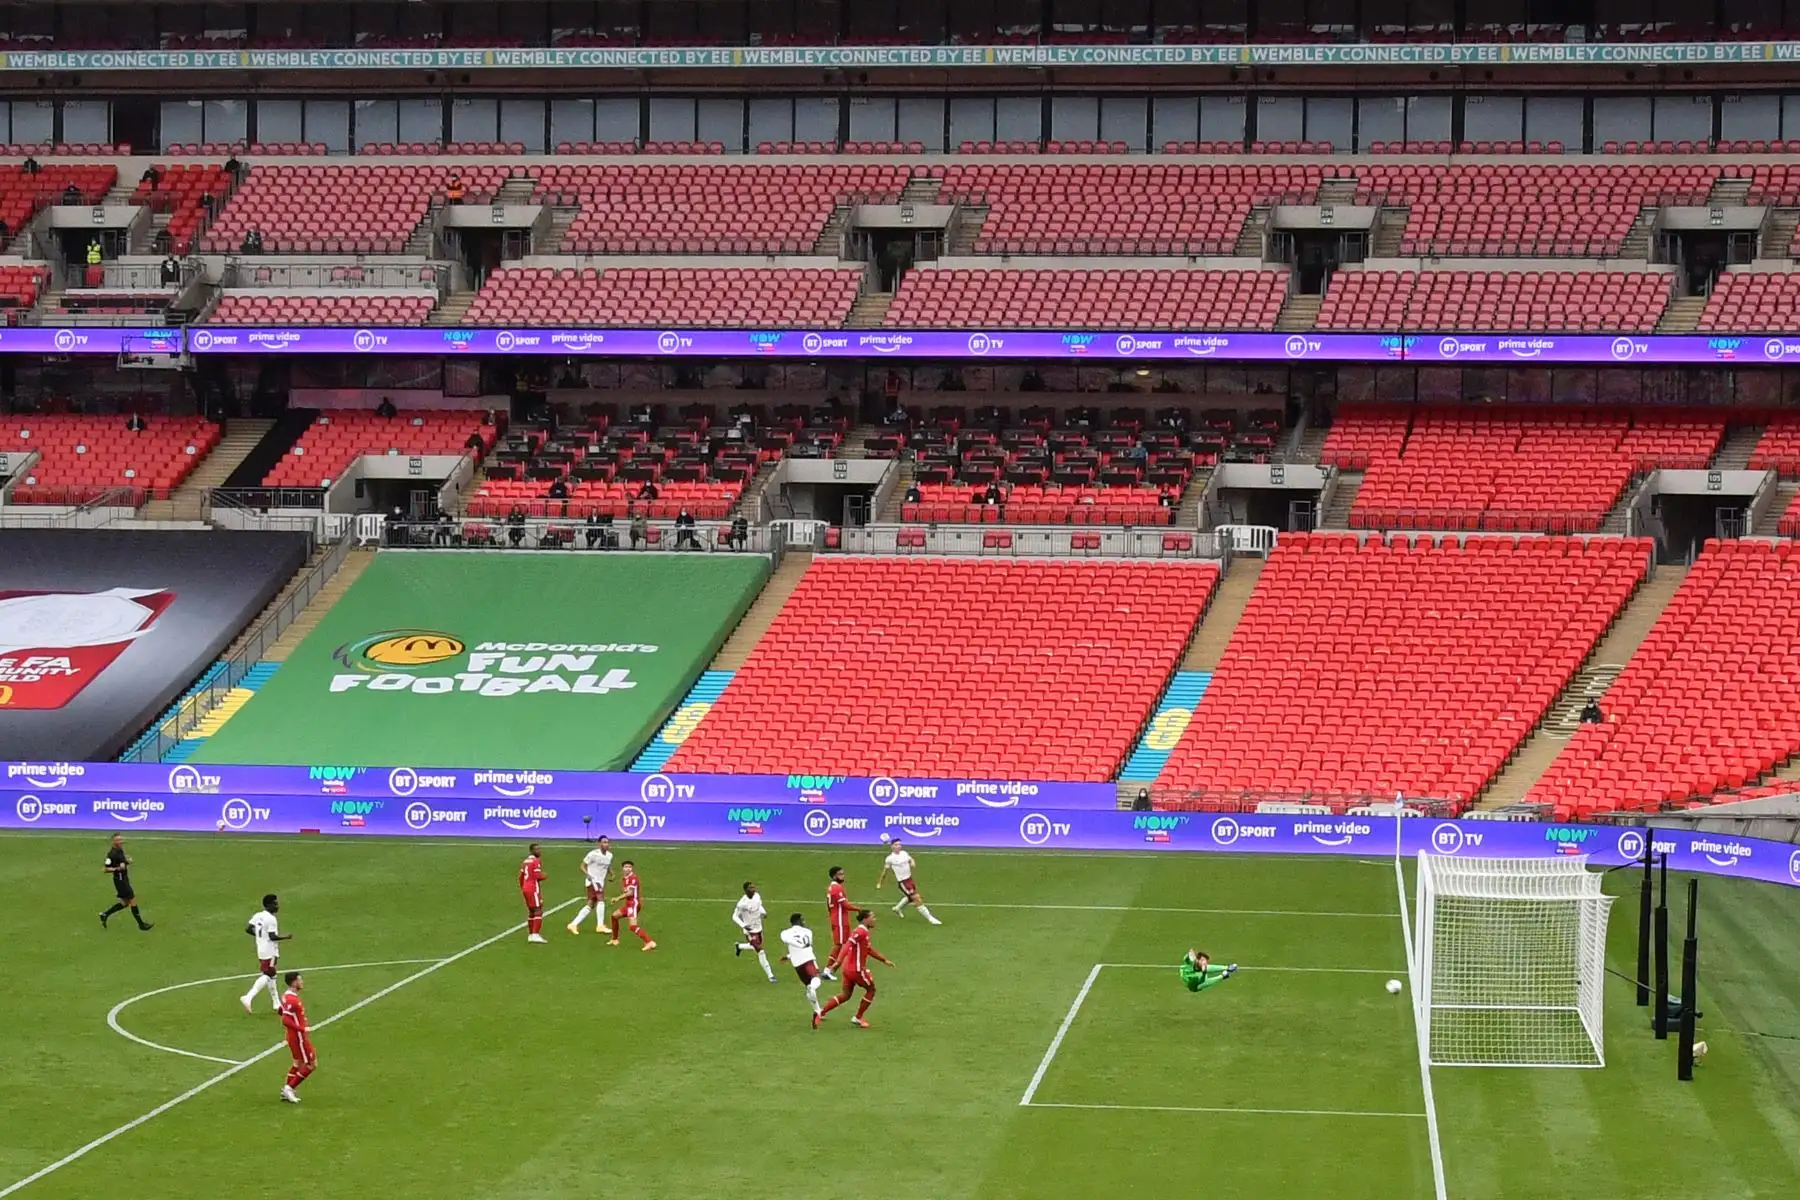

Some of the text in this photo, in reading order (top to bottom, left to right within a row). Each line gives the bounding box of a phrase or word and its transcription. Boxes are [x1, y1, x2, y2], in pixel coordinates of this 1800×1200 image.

[252, 52, 481, 66] WEMBLEY CONNECTED BY EE
[496, 51, 729, 65] WEMBLEY CONNECTED BY EE
[744, 51, 980, 64] WEMBLEY CONNECTED BY EE
[997, 49, 1237, 62] WEMBLEY CONNECTED BY EE
[1252, 48, 1497, 62] WEMBLEY CONNECTED BY EE
[1512, 47, 1760, 60] WEMBLEY CONNECTED BY EE
[1777, 46, 1800, 59] WE
[9, 53, 237, 67] WEMBLEY CONNECTED BY EE
[76, 336, 88, 344] TV
[249, 332, 300, 343] prime video
[552, 333, 603, 345] prime video
[823, 339, 847, 347] SPORT
[860, 335, 912, 347] prime video
[991, 340, 1003, 348] TV
[1175, 337, 1228, 347] prime video
[1309, 342, 1321, 351] TV
[1499, 340, 1553, 351] prime video
[473, 643, 658, 655] McDonald's
[19, 657, 70, 669] FA
[466, 653, 597, 674] FUN
[330, 668, 637, 696] FOOTBALL
[8, 763, 84, 779] prime video
[310, 767, 355, 781] NOW
[175, 776, 195, 788] BT
[396, 776, 456, 787] BT SPORT
[474, 771, 553, 787] prime video
[787, 776, 834, 788] NOW
[649, 784, 694, 797] BT TV
[876, 785, 938, 797] BT SPORT
[957, 782, 1038, 797] prime video
[22, 803, 77, 814] BT SPORT
[94, 799, 164, 813] prime video
[331, 801, 373, 813] NOW
[228, 807, 270, 820] BT TV
[412, 810, 467, 821] BT SPORT
[484, 807, 556, 821] prime video
[728, 809, 771, 821] NOW
[623, 815, 665, 828] BT TV
[809, 817, 867, 829] BT SPORT
[885, 813, 959, 828] prime video
[1134, 816, 1178, 829] NOW
[1027, 824, 1070, 837] BT TV
[1218, 826, 1276, 837] BT SPORT
[1294, 821, 1370, 835] prime video
[1438, 832, 1482, 845] BT TV
[1546, 828, 1587, 843] NOW
[1624, 840, 1676, 854] BT PORT
[1691, 840, 1751, 858] prime video
